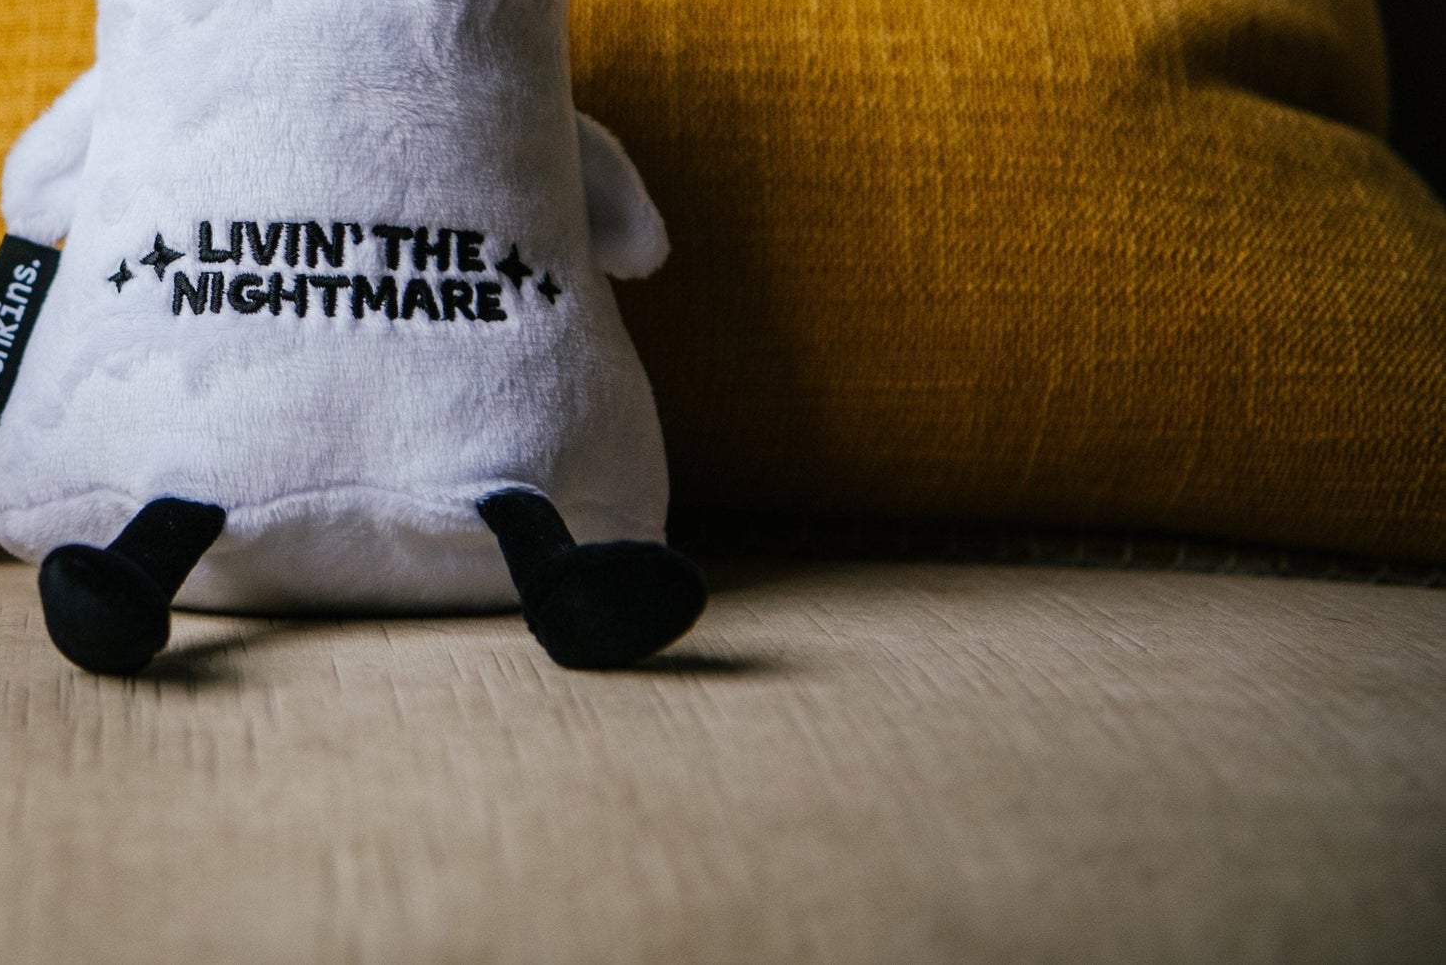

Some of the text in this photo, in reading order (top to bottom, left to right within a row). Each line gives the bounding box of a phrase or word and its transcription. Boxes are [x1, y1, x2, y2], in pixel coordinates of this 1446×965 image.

[197, 220, 487, 273] LIVIN' THE
[171, 270, 508, 323] NIGHTMARE
